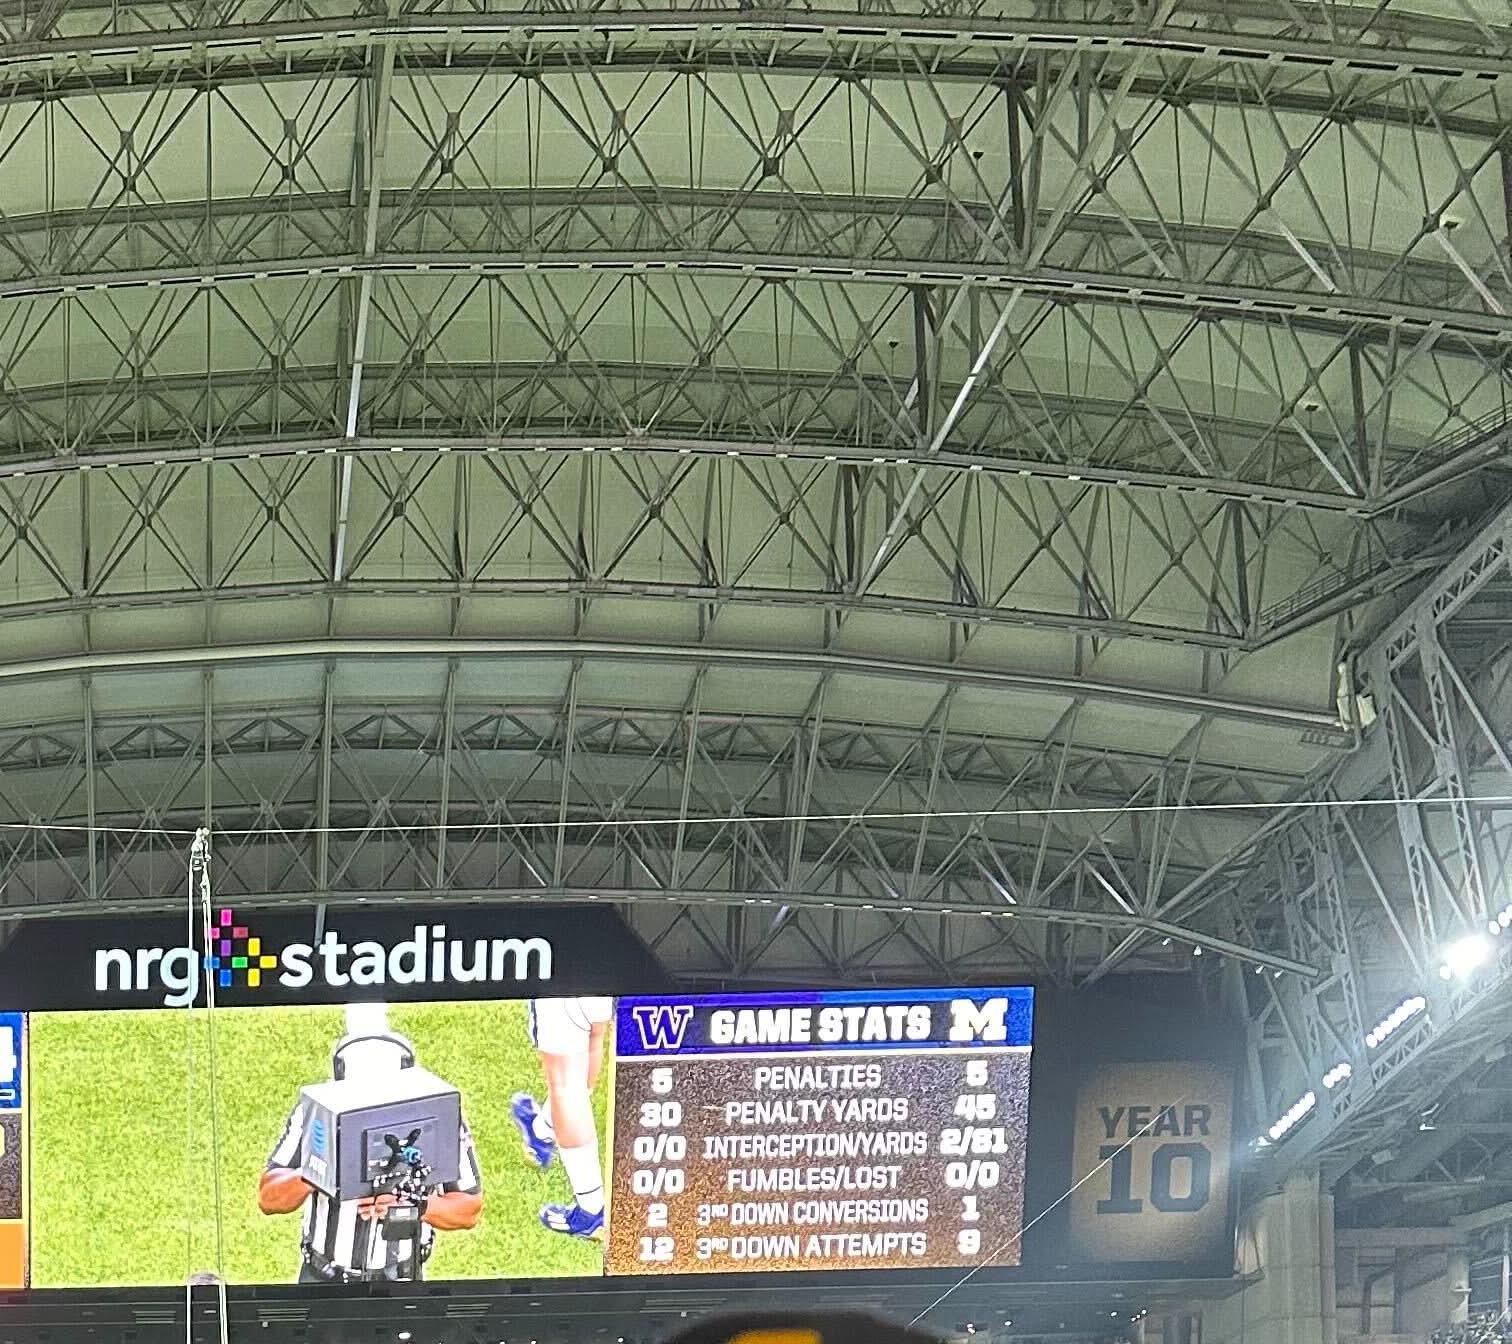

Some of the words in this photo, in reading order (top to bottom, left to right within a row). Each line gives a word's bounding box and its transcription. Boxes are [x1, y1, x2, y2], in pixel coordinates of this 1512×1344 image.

[94, 947, 199, 1007] nrg
[278, 925, 552, 988] stadium
[633, 1006, 694, 1049] W
[710, 1007, 812, 1044] GAME
[818, 1005, 931, 1042] STATS
[949, 997, 1009, 1041] M
[755, 1063, 882, 1090] PENALTIES
[726, 1099, 827, 1126] PENALTY
[832, 1097, 909, 1122] YARDS
[954, 1093, 996, 1120] 45
[1096, 1104, 1212, 1138] YEAR
[633, 1134, 686, 1163] 0/0
[703, 1131, 928, 1160] INTERCEPTION/YARDS
[632, 1168, 685, 1197] 0/0
[727, 1165, 903, 1192] FUMBLES/LOST
[945, 1160, 1000, 1189] 0/0
[1096, 1142, 1212, 1215] 10
[647, 1203, 669, 1227] 2
[731, 1202, 788, 1225] DOWN
[793, 1197, 929, 1225] CONVERSIONS
[961, 1195, 980, 1221] 1
[640, 1236, 675, 1262] 12
[731, 1235, 799, 1259] DOWN
[804, 1231, 927, 1258] ATTEMPTS
